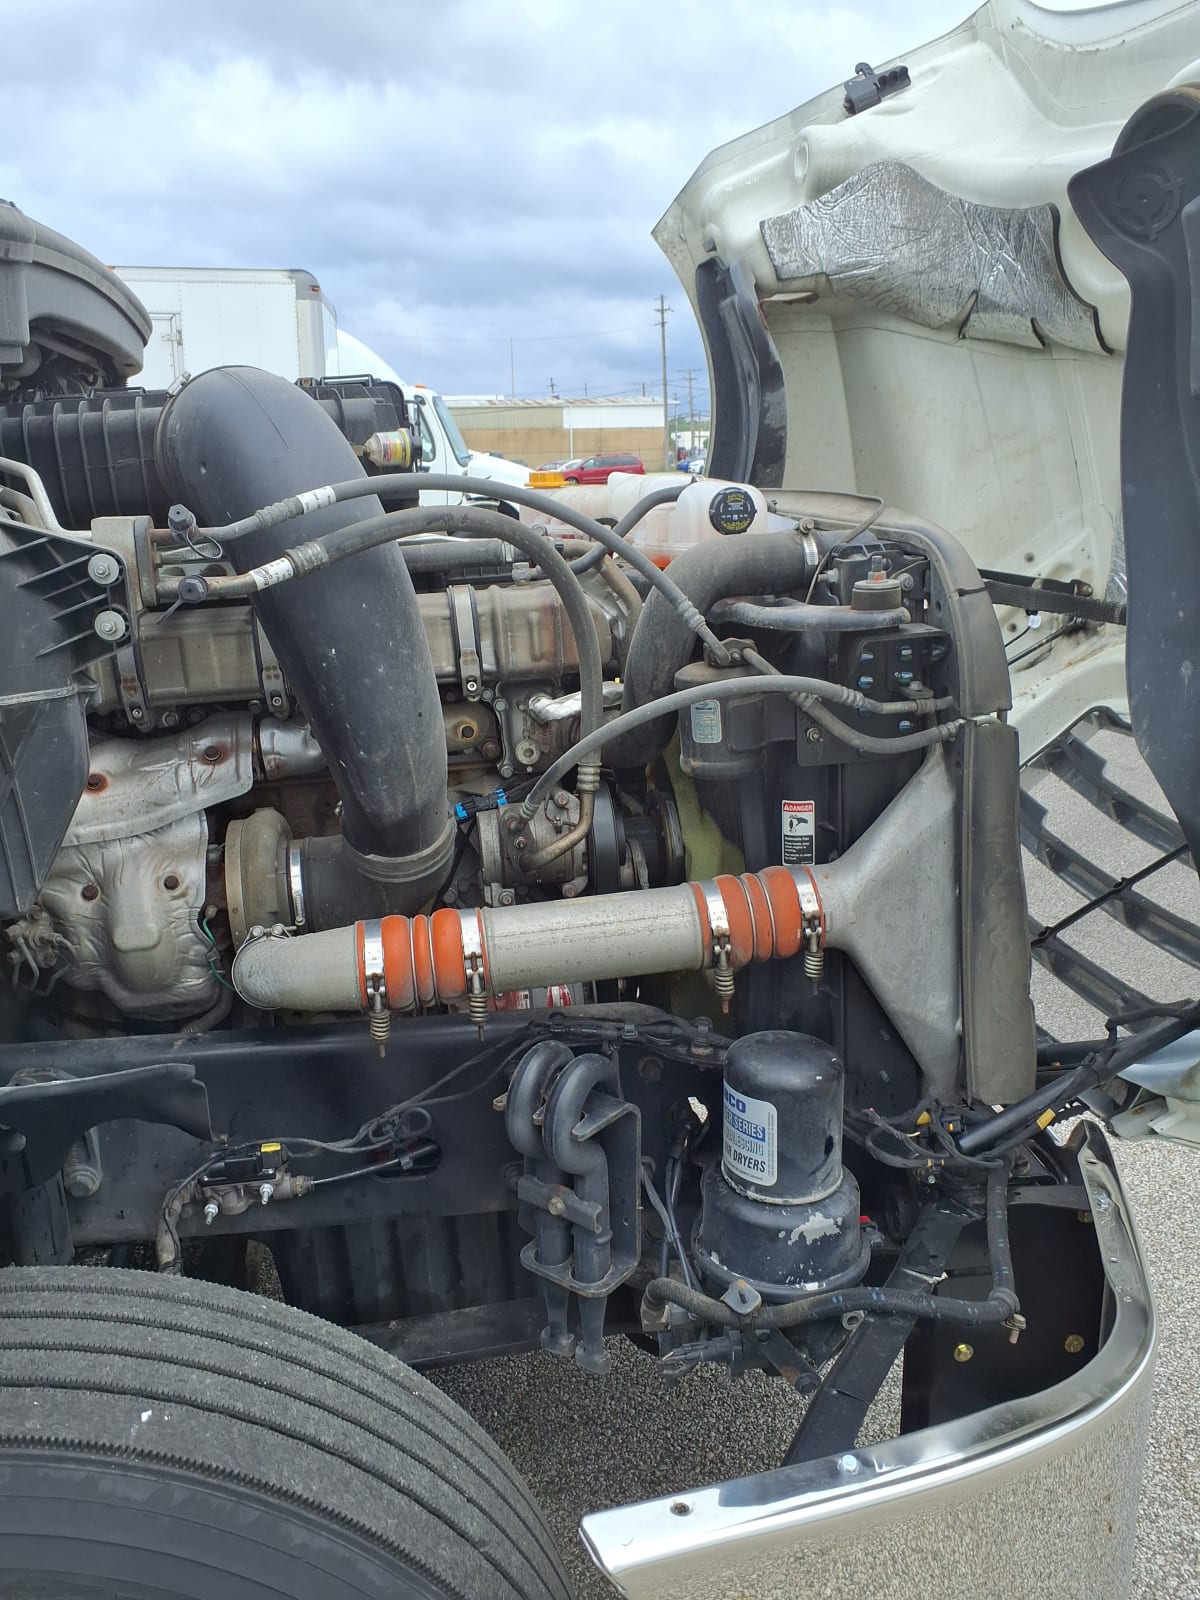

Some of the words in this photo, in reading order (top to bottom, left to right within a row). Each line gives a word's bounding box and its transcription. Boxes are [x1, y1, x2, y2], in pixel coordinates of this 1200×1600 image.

[789, 804, 812, 812] DANGER
[734, 1116, 763, 1139] SERIES
[733, 1149, 766, 1173] DRYERS
